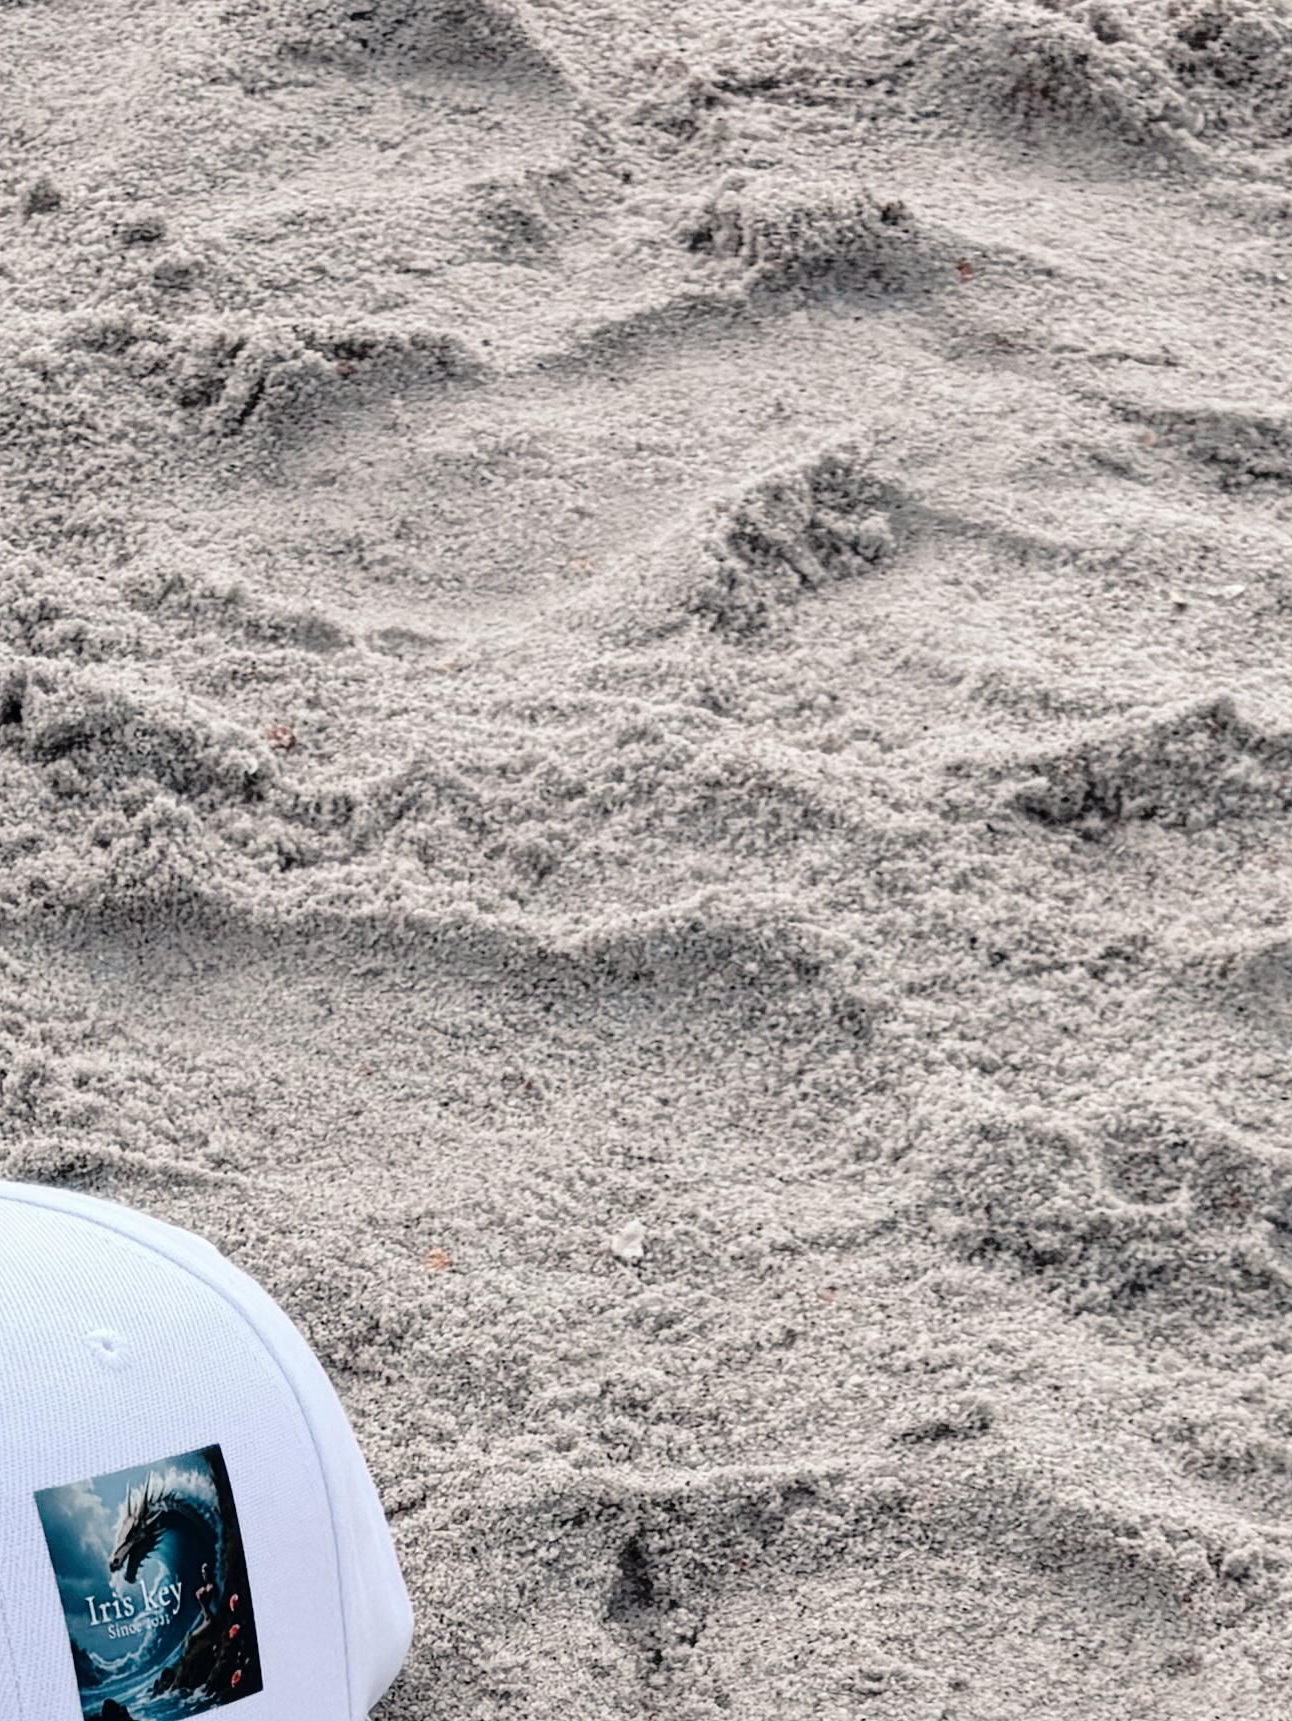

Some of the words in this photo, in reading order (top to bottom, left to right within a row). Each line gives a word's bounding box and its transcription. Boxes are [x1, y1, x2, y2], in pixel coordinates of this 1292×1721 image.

[85, 1592, 134, 1626] Iris
[140, 1579, 182, 1615] key
[108, 1621, 142, 1639] Since
